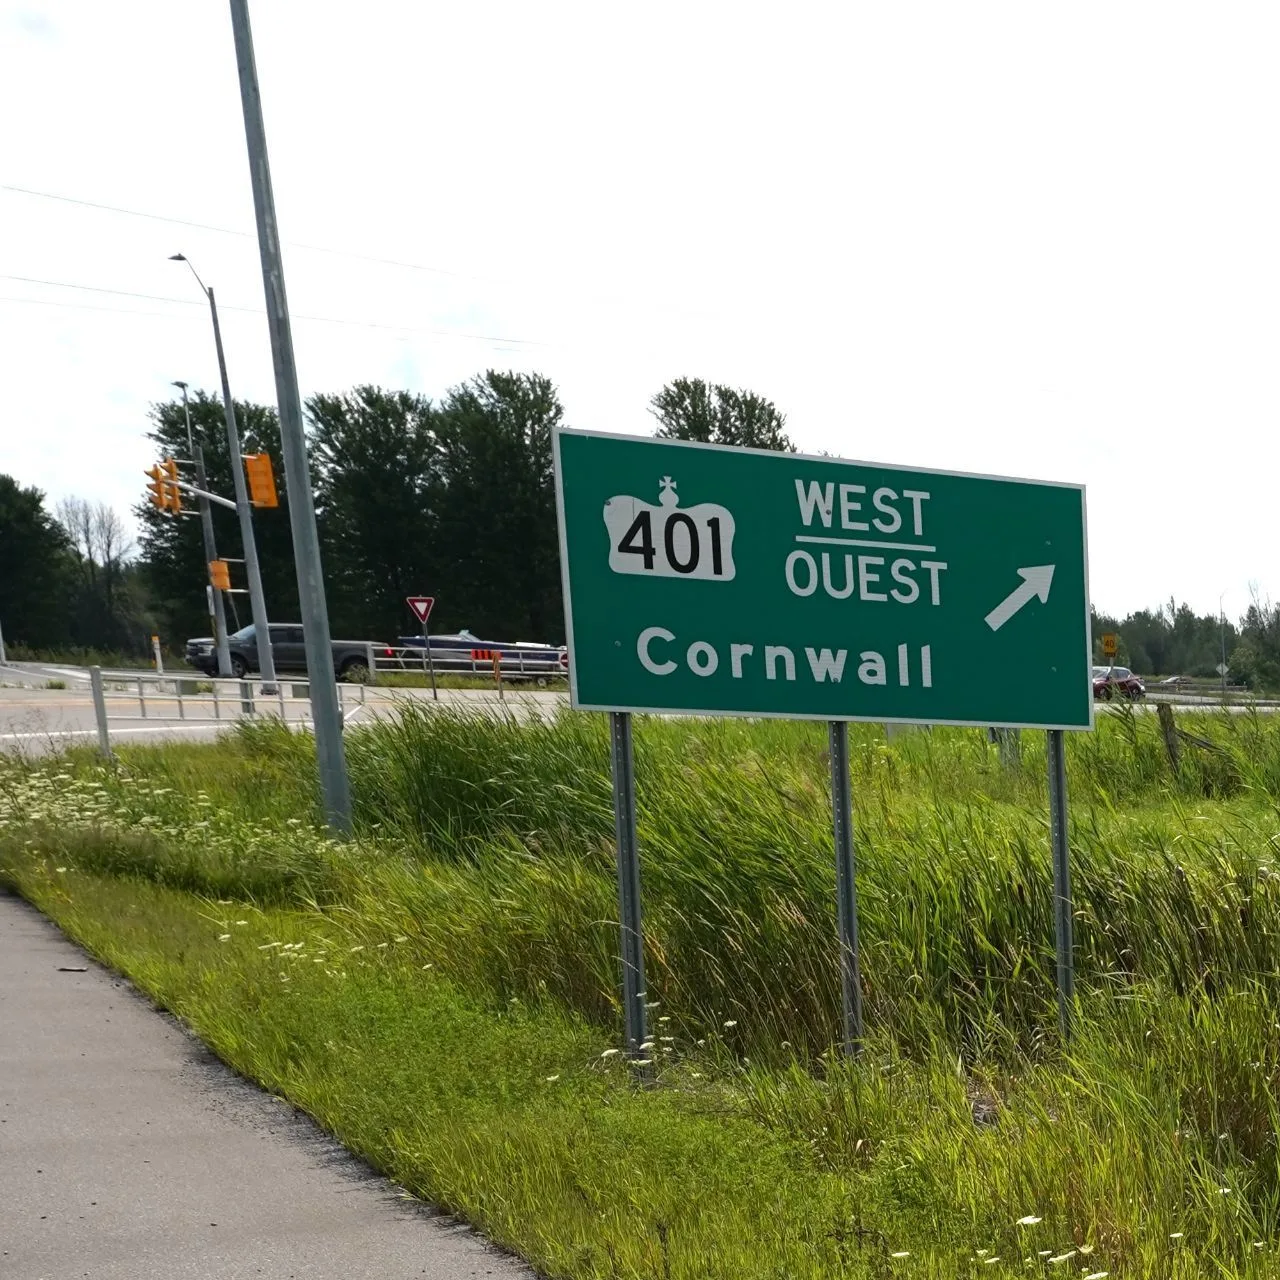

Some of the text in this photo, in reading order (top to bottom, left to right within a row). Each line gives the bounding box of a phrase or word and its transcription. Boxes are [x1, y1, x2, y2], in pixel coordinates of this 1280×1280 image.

[794, 479, 931, 536] WEST
[617, 510, 724, 576] 401
[784, 549, 948, 606] OUEST
[636, 626, 932, 688] Cornwall
